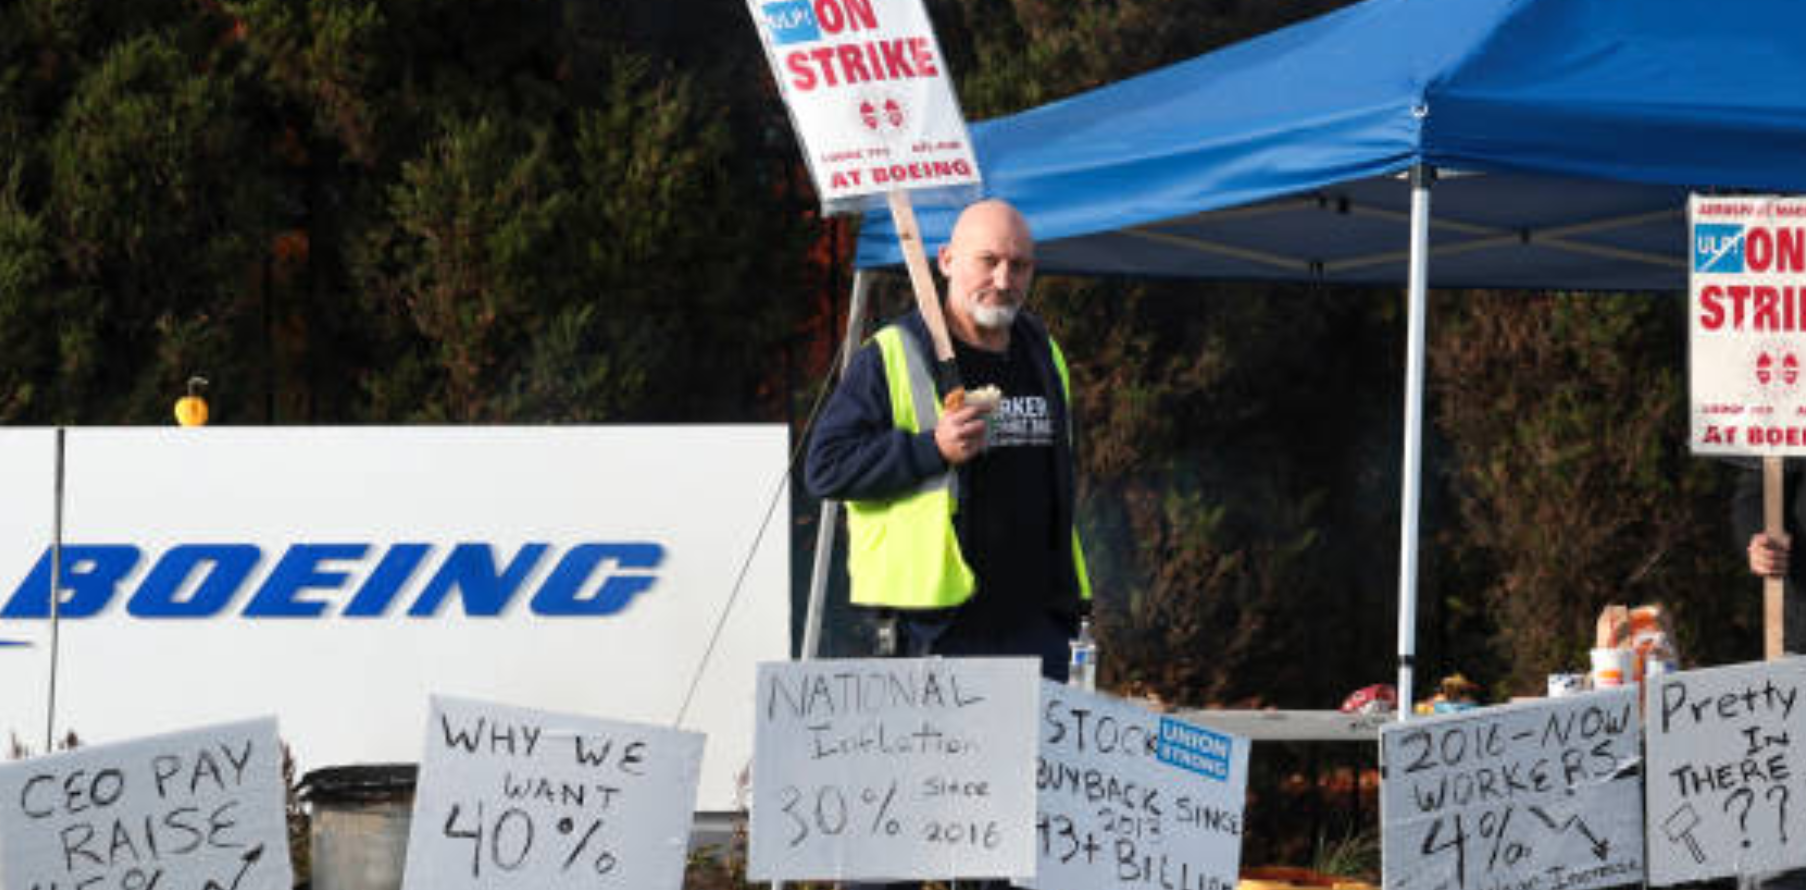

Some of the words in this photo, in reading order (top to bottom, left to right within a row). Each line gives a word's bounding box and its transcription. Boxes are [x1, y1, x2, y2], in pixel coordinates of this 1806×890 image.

[813, 0, 878, 34] ON
[786, 37, 939, 91] STRIKE
[831, 171, 861, 188] AT
[871, 158, 972, 183] BOEING
[1745, 227, 1805, 273] ON
[1700, 286, 1806, 331] STRI
[1702, 425, 1737, 445] AT
[1, 543, 666, 618] BOEING
[767, 671, 987, 721] NATIONAL
[1662, 681, 1796, 733] Pretty
[442, 714, 541, 756] WHY
[575, 735, 647, 776] WE
[1045, 700, 1158, 757] STOCK
[1161, 721, 1228, 758] UNION
[21, 769, 124, 819] CEO
[153, 740, 252, 799] PAY
[504, 773, 620, 808] WANT
[1036, 757, 1161, 816] BUYBACK
[1175, 798, 1242, 836] SINCE
[1414, 740, 1618, 812] WORKERS
[1669, 755, 1790, 796] THERE
[61, 801, 247, 871] RAISE
[925, 821, 1003, 849] 2016
